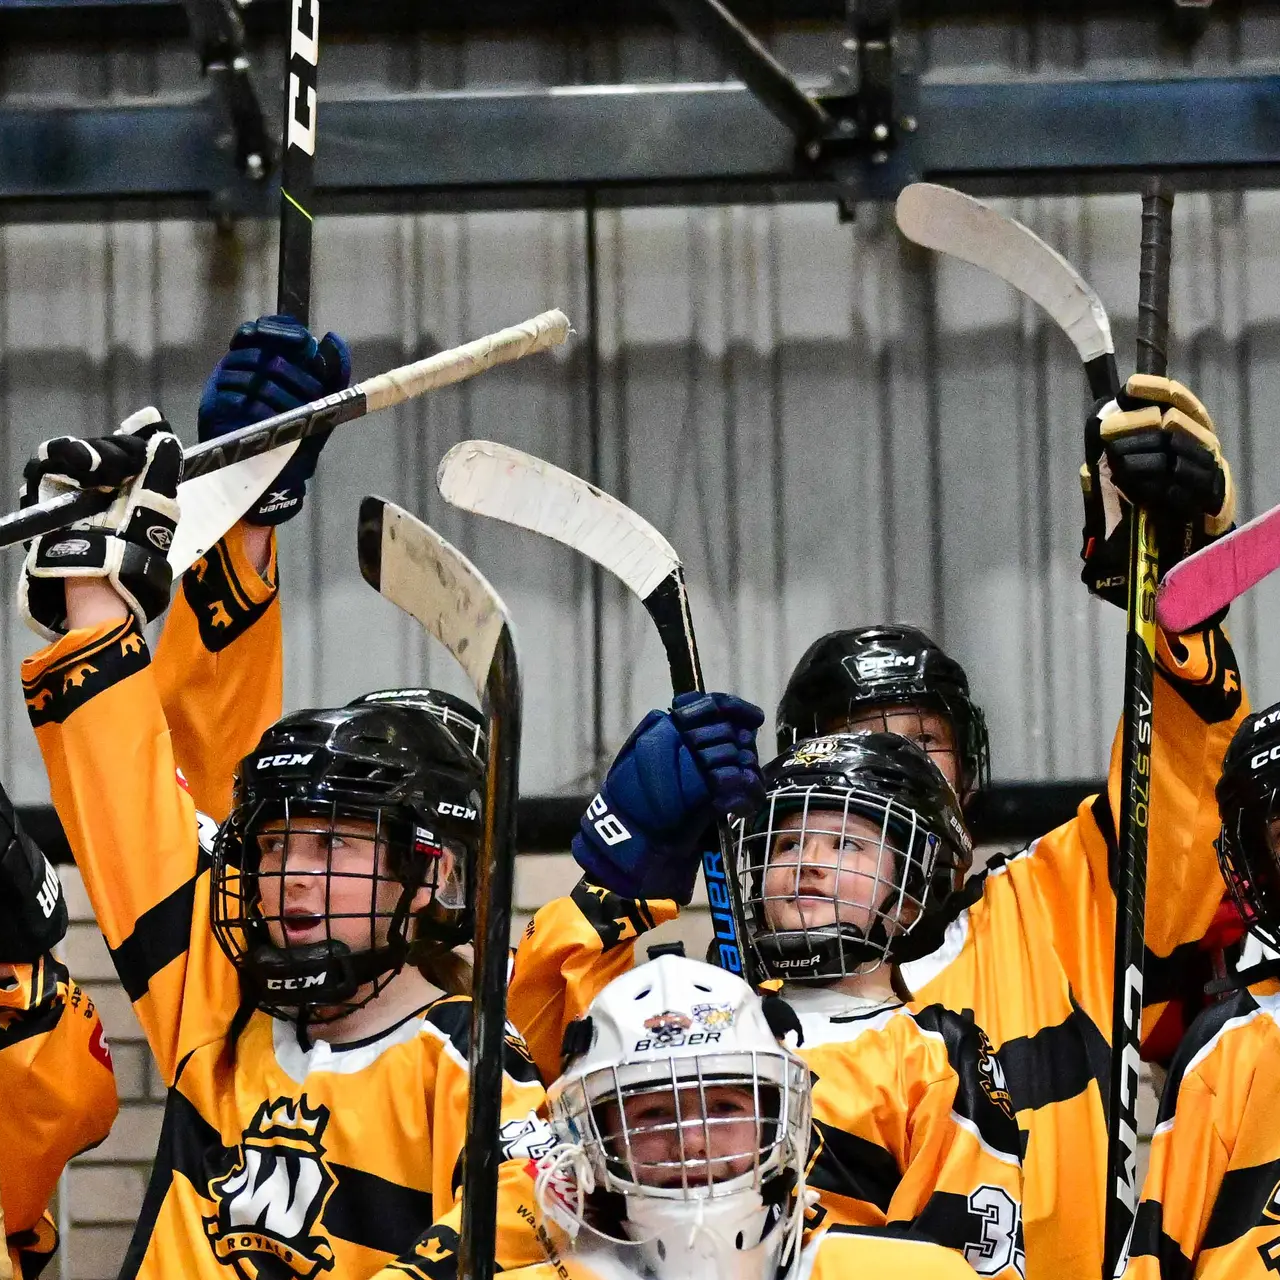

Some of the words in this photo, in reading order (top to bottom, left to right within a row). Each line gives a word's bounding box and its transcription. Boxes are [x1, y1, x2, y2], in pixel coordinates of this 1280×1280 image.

[287, 0, 320, 157] CC
[259, 498, 298, 514] BAUER
[1095, 576, 1126, 589] CM
[256, 753, 315, 770] CCM
[1135, 754, 1150, 828] 570
[437, 801, 477, 821] CCM
[949, 815, 974, 851] BAUER
[702, 851, 743, 974] AUER
[772, 954, 822, 970] BAUER
[267, 971, 328, 992] CCM
[1116, 963, 1144, 1216] CCM
[221, 1148, 324, 1240] W
[963, 1184, 1026, 1280] 3
